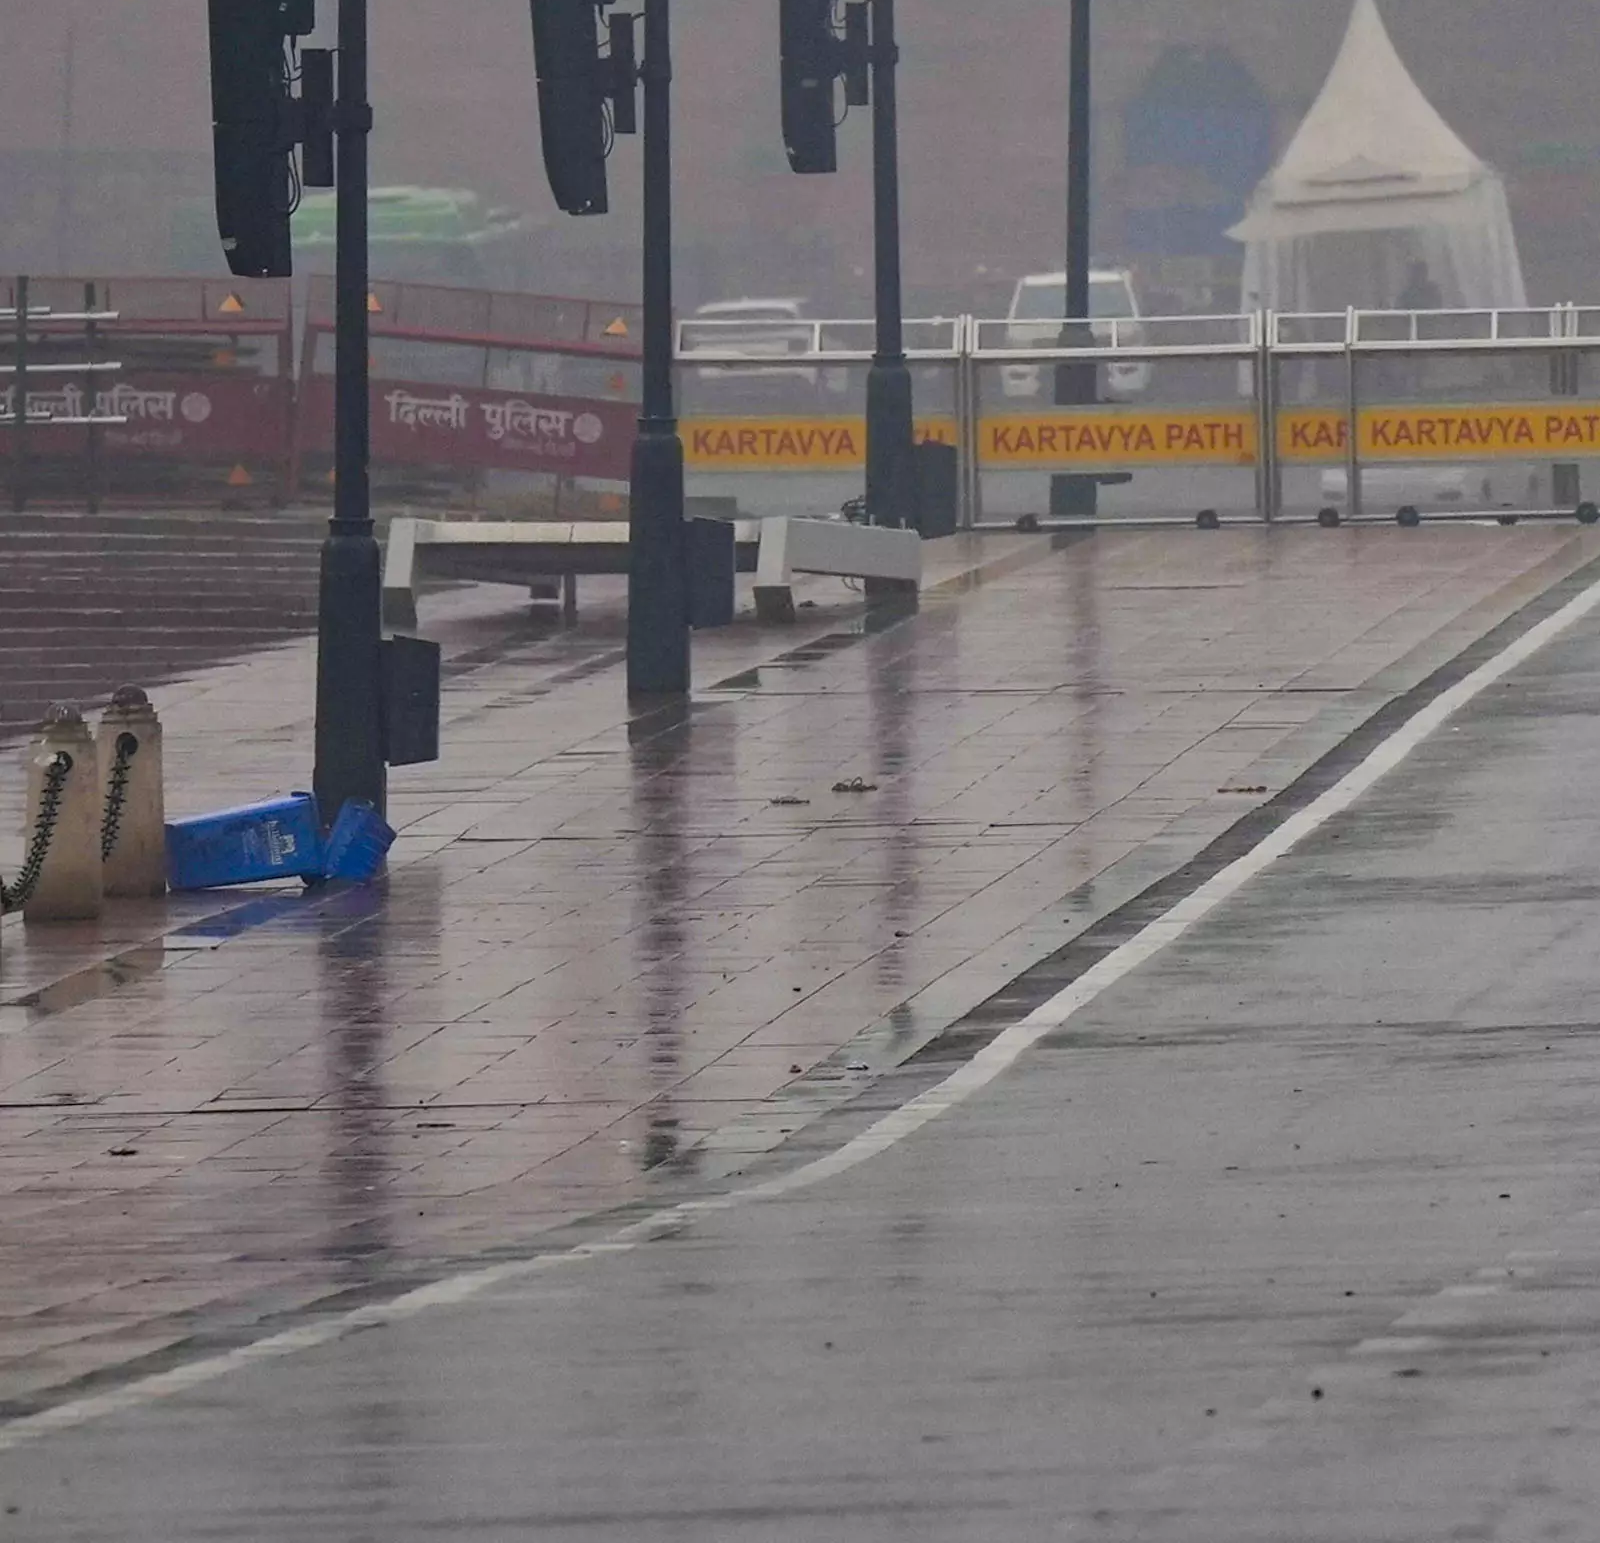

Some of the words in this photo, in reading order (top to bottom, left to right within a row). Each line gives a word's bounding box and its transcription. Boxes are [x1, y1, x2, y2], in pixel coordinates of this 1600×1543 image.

[384, 389, 470, 432] दिल्ली
[480, 399, 574, 440] पुलिस
[693, 429, 857, 456] KARTAVYA
[992, 425, 1156, 453] KARTAVYA
[1165, 422, 1244, 450] PATH
[1371, 417, 1534, 446] KARTAVYA
